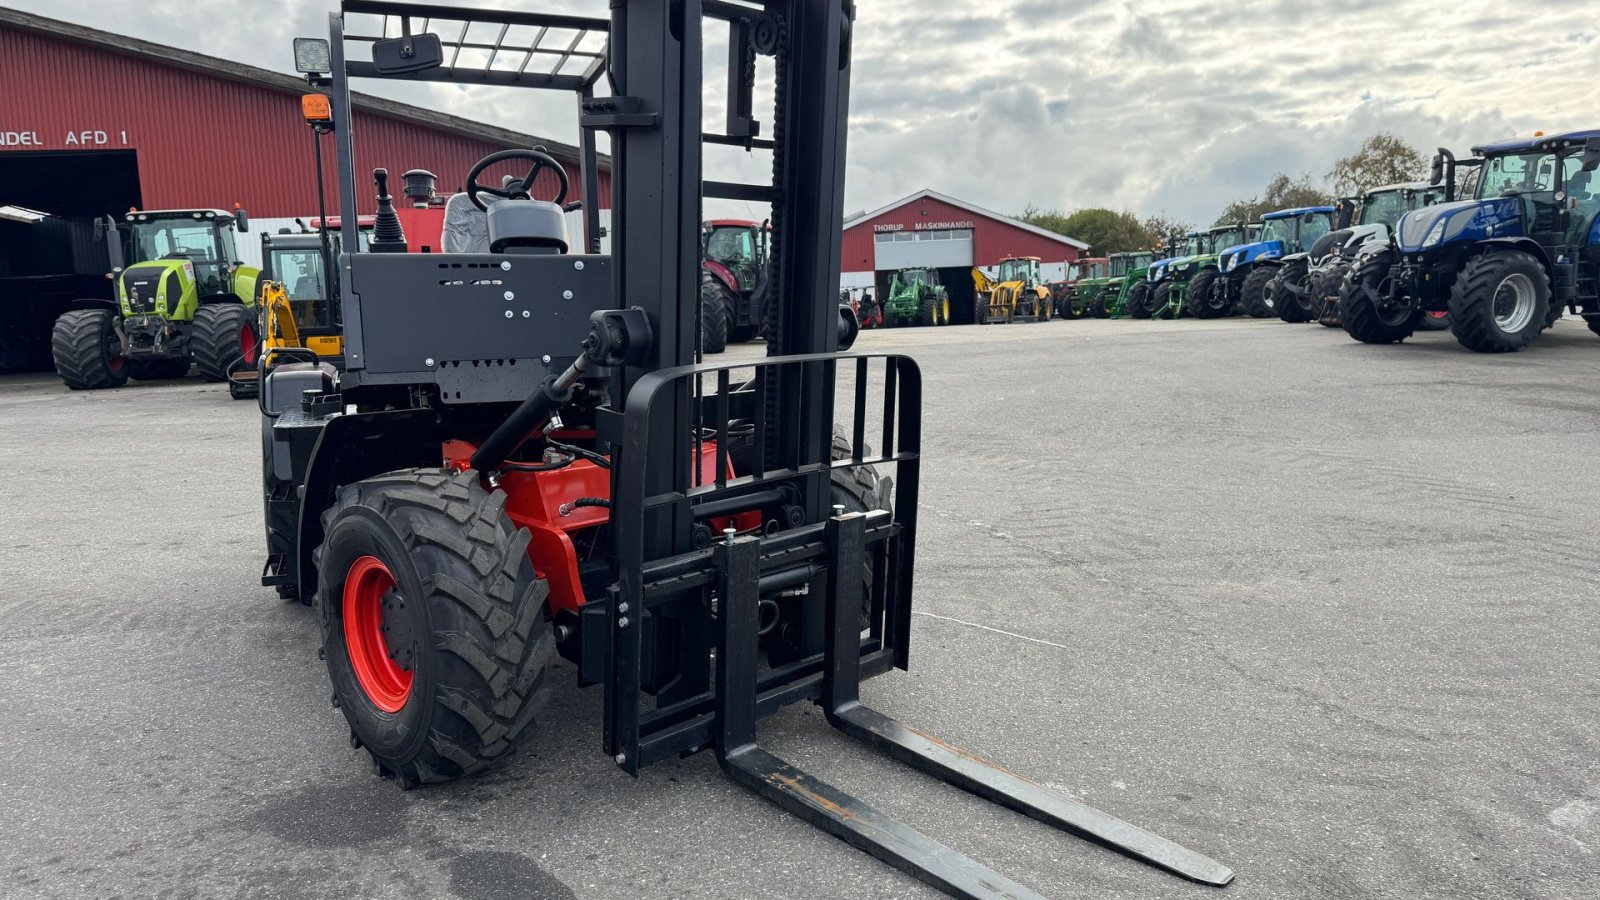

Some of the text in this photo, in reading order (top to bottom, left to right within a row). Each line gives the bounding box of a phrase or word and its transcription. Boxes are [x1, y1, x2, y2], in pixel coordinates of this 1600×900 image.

[65, 130, 108, 145] AFD
[121, 130, 127, 145] 1
[873, 221, 976, 231] THORUP MASKINHANDEL
